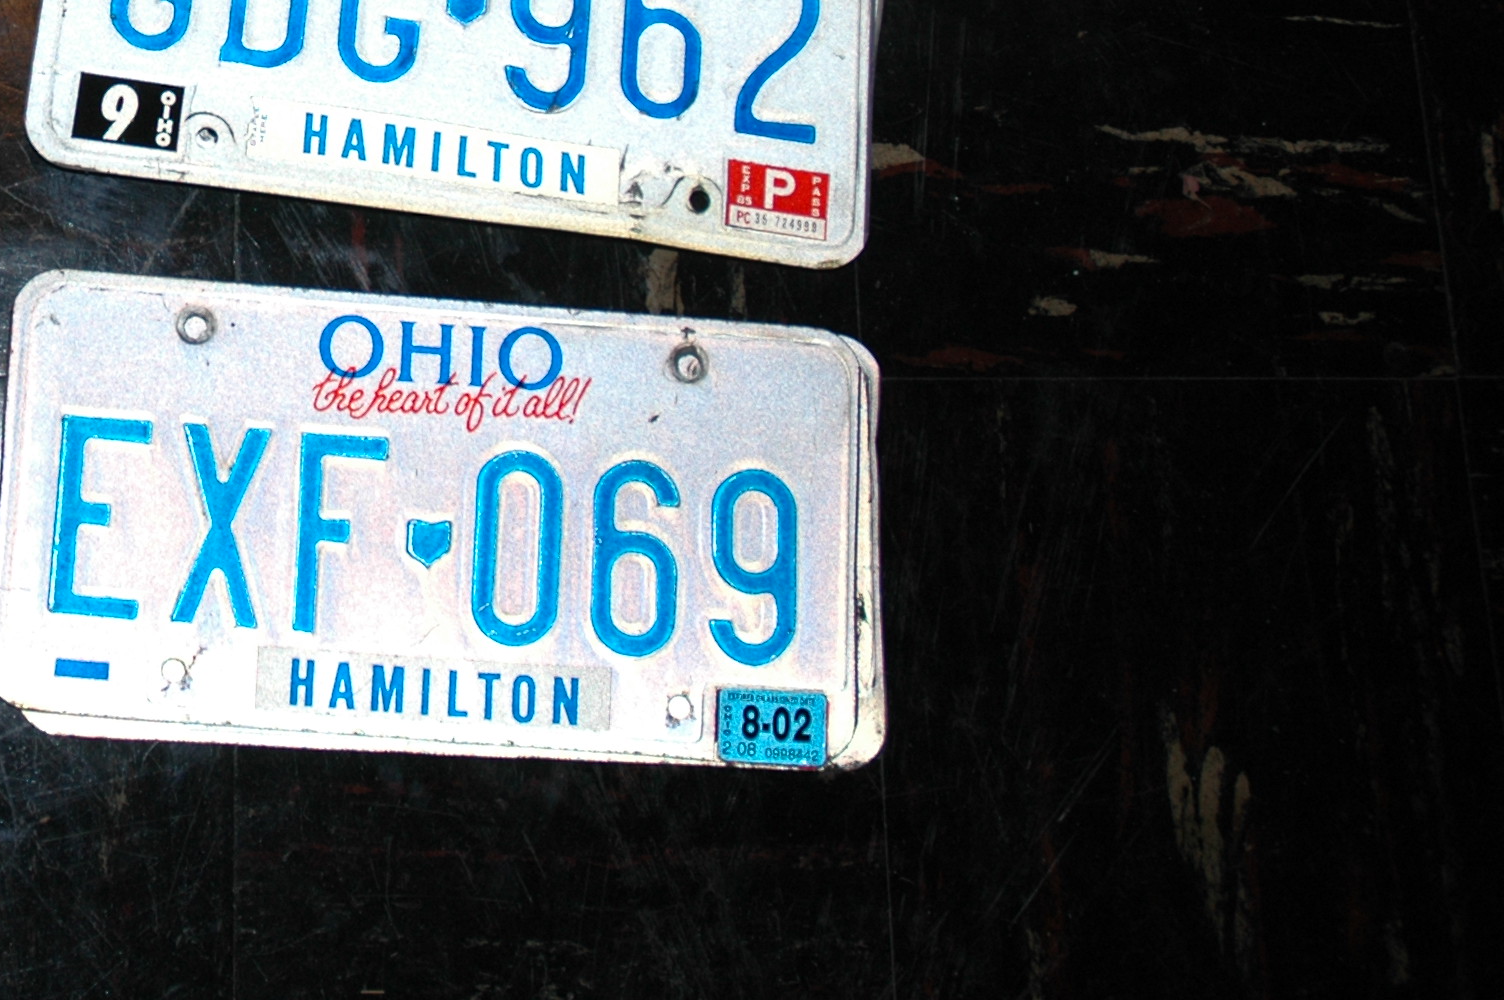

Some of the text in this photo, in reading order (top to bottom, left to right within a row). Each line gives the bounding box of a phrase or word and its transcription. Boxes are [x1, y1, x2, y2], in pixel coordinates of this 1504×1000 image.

[303, 112, 586, 196] HAMILTON
[740, 164, 751, 193] EXP
[764, 167, 796, 210] P
[811, 176, 822, 217] PASS
[736, 210, 751, 224] PC
[319, 314, 563, 391] OHIO
[312, 366, 364, 413] the
[351, 367, 457, 420] heart
[454, 372, 497, 433] of
[492, 374, 527, 418] it
[289, 657, 580, 726] HAMILTON
[723, 705, 732, 736] OHIO
[741, 704, 813, 742] 8-02
[722, 741, 732, 755] 2
[737, 742, 757, 757] 08
